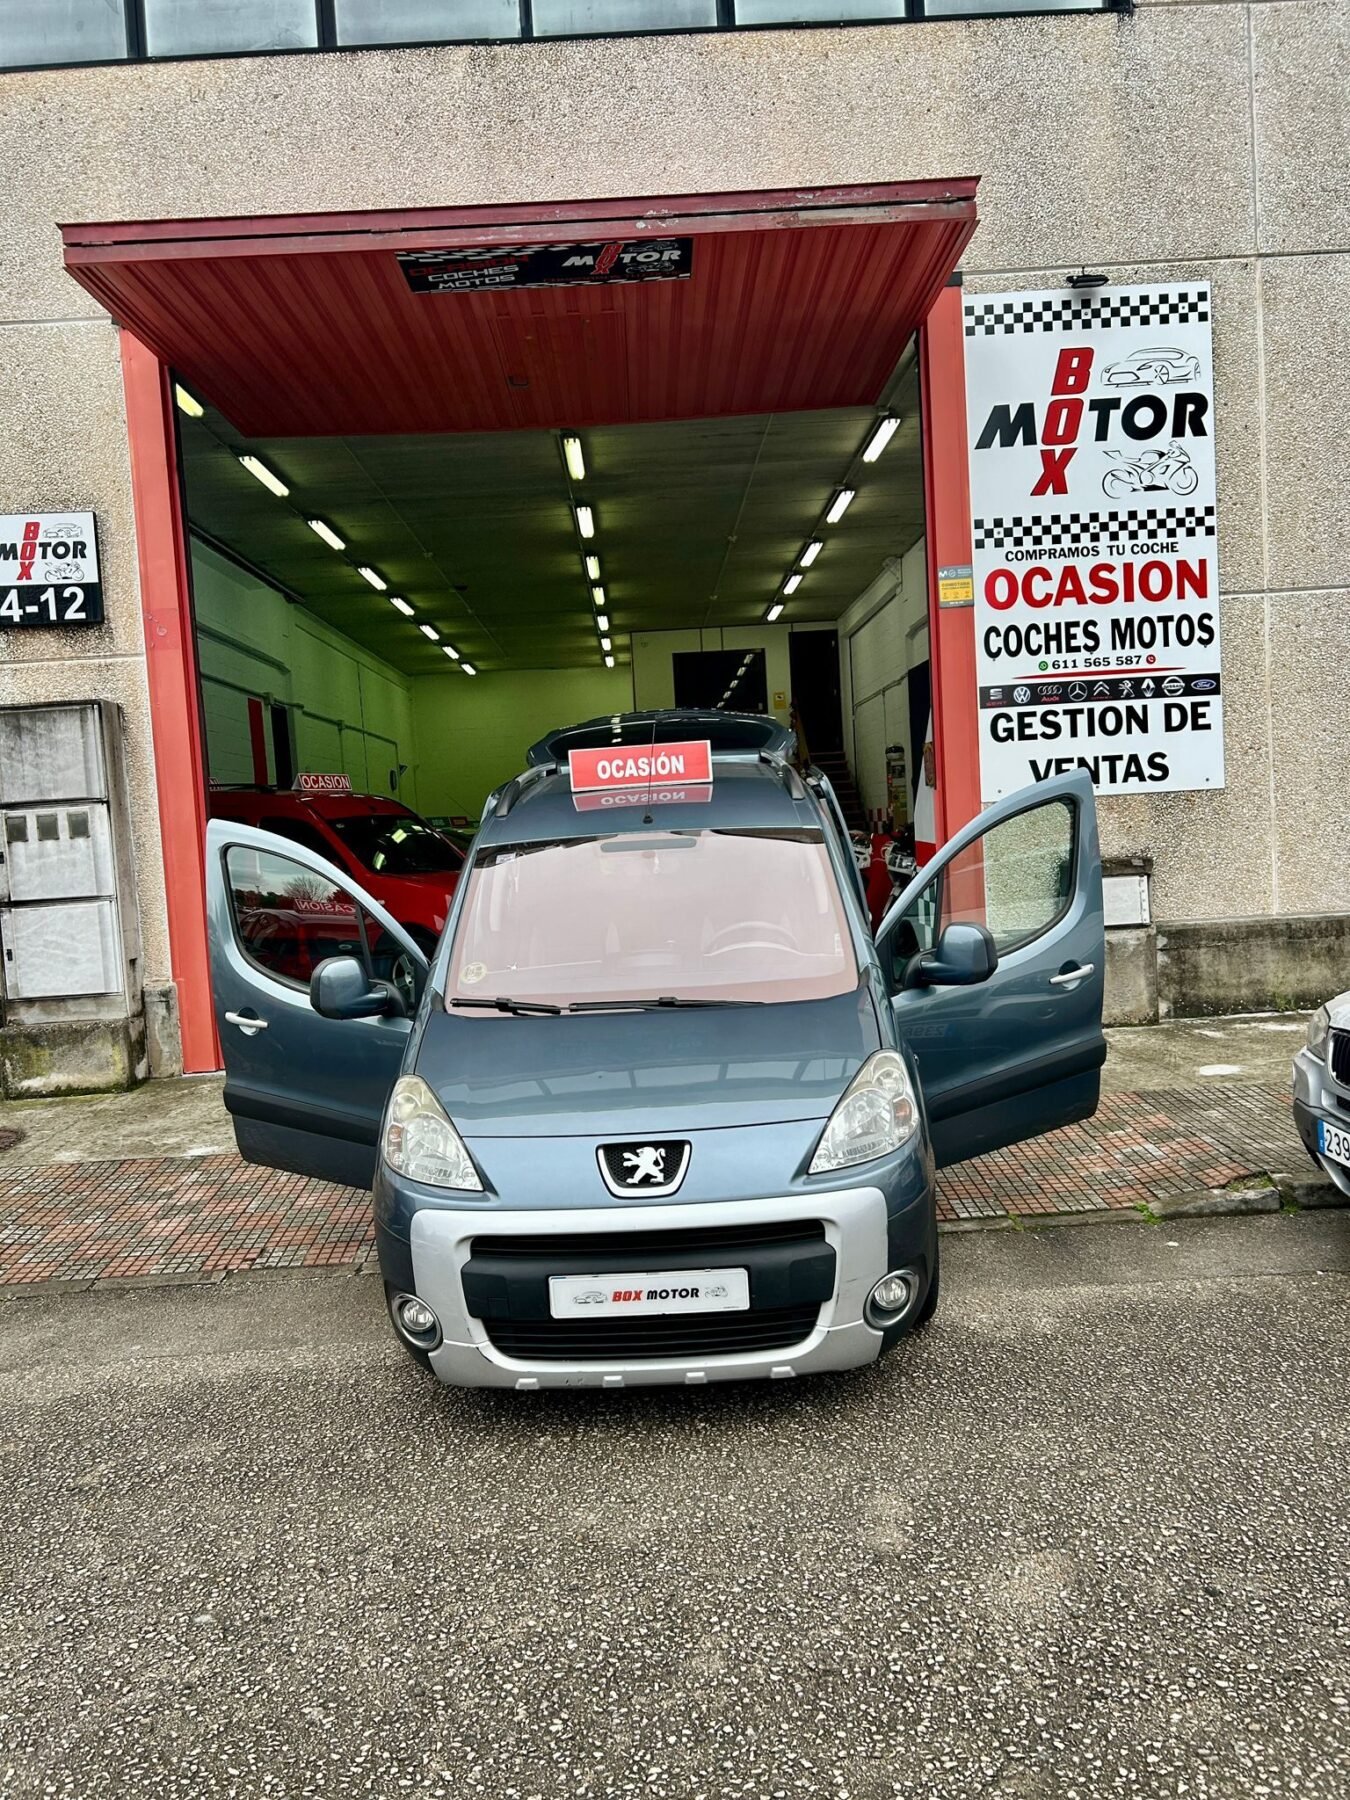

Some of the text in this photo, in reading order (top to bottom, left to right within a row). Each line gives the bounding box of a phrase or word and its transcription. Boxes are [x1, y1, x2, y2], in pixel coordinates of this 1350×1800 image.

[561, 250, 682, 267] MOTOR
[427, 264, 520, 282] COCHES
[438, 274, 516, 289] MOTOS
[974, 391, 1209, 450] MOTOR
[1030, 347, 1095, 496] BOX
[16, 521, 40, 581] BOX
[1004, 541, 1180, 562] COMPRAMOS TU COCHE
[984, 558, 1208, 610] OCASION
[983, 612, 1215, 659] COCHES MOTOS
[1051, 655, 1142, 670] 611 565 587
[990, 701, 1212, 743] GESTION DE
[597, 752, 685, 779] OCASIÓN
[301, 775, 350, 789] OCASION
[612, 1287, 700, 1303] BOX MOTOR
